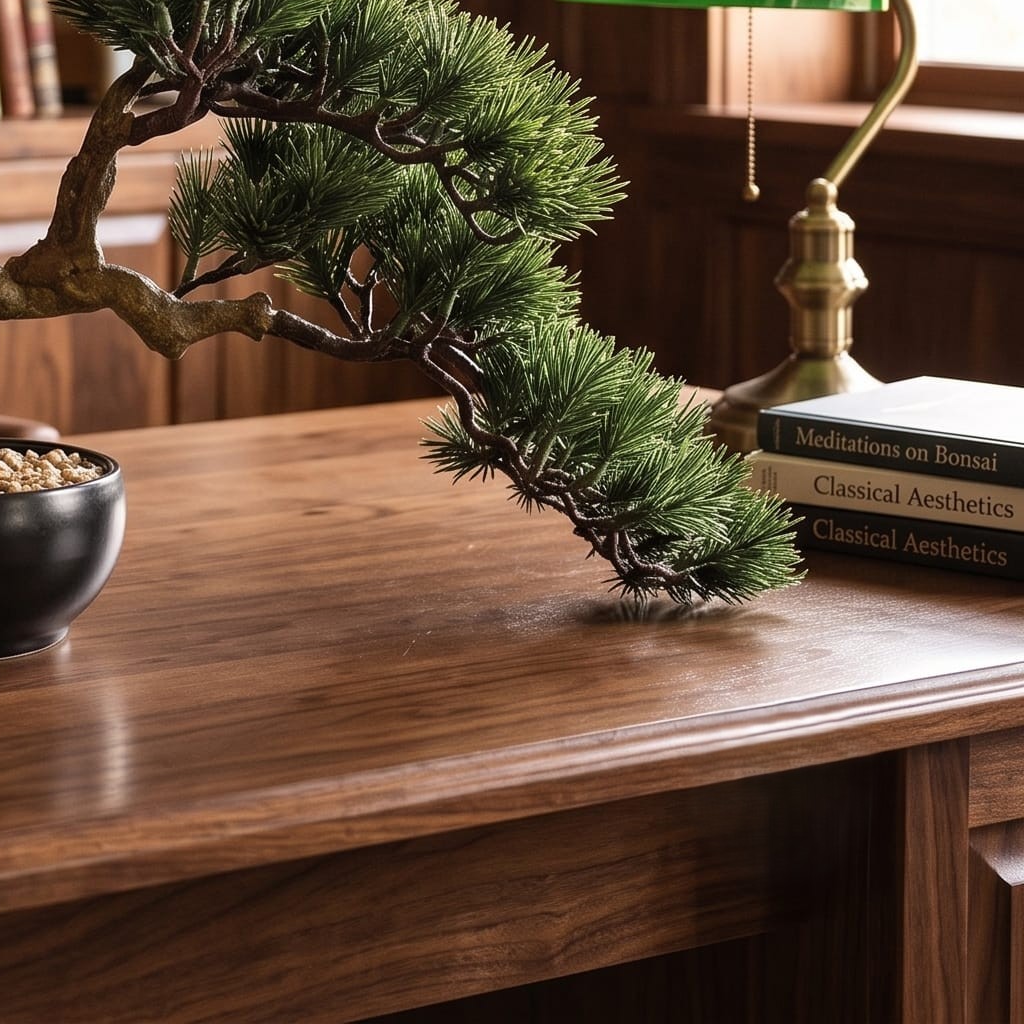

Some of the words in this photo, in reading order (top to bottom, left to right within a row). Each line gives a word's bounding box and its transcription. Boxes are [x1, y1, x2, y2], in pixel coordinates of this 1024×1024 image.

[794, 426, 901, 458] Meditations
[905, 444, 929, 462] on
[935, 444, 998, 472] Bonsai
[813, 475, 900, 504] Classical
[907, 486, 1015, 518] Aesthetics
[812, 518, 897, 550] Classical
[903, 531, 1008, 566] Aesthetics
